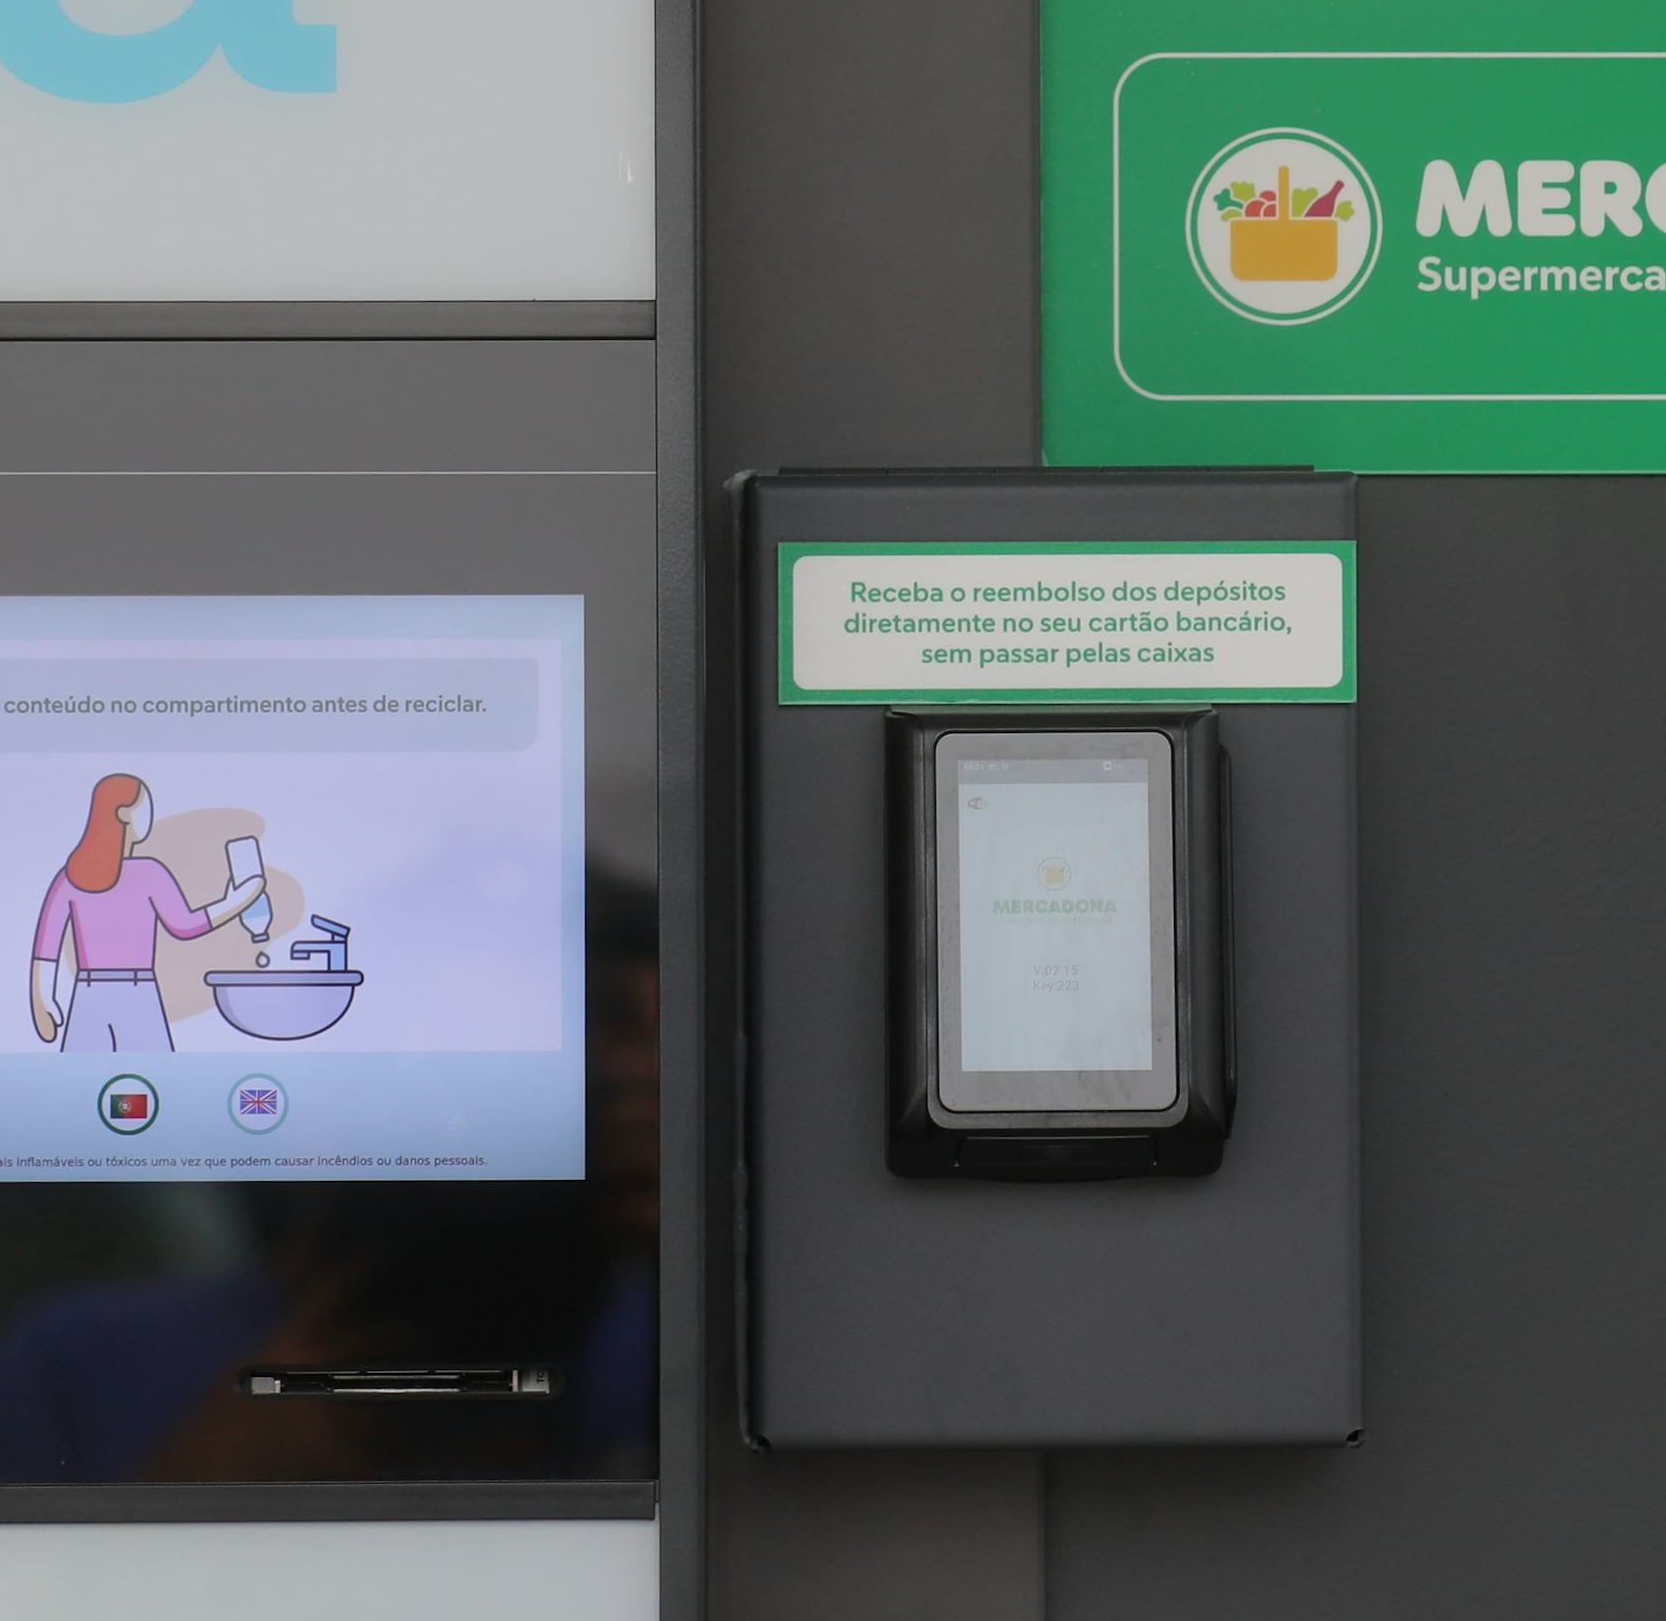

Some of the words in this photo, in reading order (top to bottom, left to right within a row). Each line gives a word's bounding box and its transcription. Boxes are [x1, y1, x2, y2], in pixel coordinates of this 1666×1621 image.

[851, 581, 944, 603] Receba
[950, 587, 966, 603] o
[973, 580, 1106, 603] reembolso
[1112, 580, 1157, 602] dos
[1163, 580, 1286, 606] depósitos
[844, 612, 996, 634] diretamente
[1003, 617, 1034, 633] no
[1040, 617, 1081, 633] seu
[1088, 611, 1169, 633] cartão
[1176, 610, 1292, 635] bancário,
[921, 648, 972, 664] sem
[979, 647, 1060, 669] passar
[1066, 641, 1131, 668] pelas
[1137, 641, 1215, 663] caixas
[3, 695, 105, 714] conteúdo
[111, 700, 137, 714] no
[142, 695, 307, 718] compartimento
[311, 696, 368, 713] antes
[372, 694, 400, 713] de
[405, 694, 487, 713] reciclar.
[992, 899, 1118, 915] MERCADONA
[16, 1155, 85, 1168] inflamáveis
[87, 1158, 103, 1167] ou
[105, 1156, 148, 1167] tóxicos
[150, 1158, 177, 1167] uma
[180, 1158, 202, 1167] vez
[204, 1158, 227, 1169] que
[230, 1155, 272, 1169] podem
[274, 1157, 315, 1167] causar
[317, 1155, 374, 1167] incêndios
[376, 1157, 392, 1166] ou
[394, 1155, 431, 1166] danos
[433, 1155, 488, 1168] pessoais.
